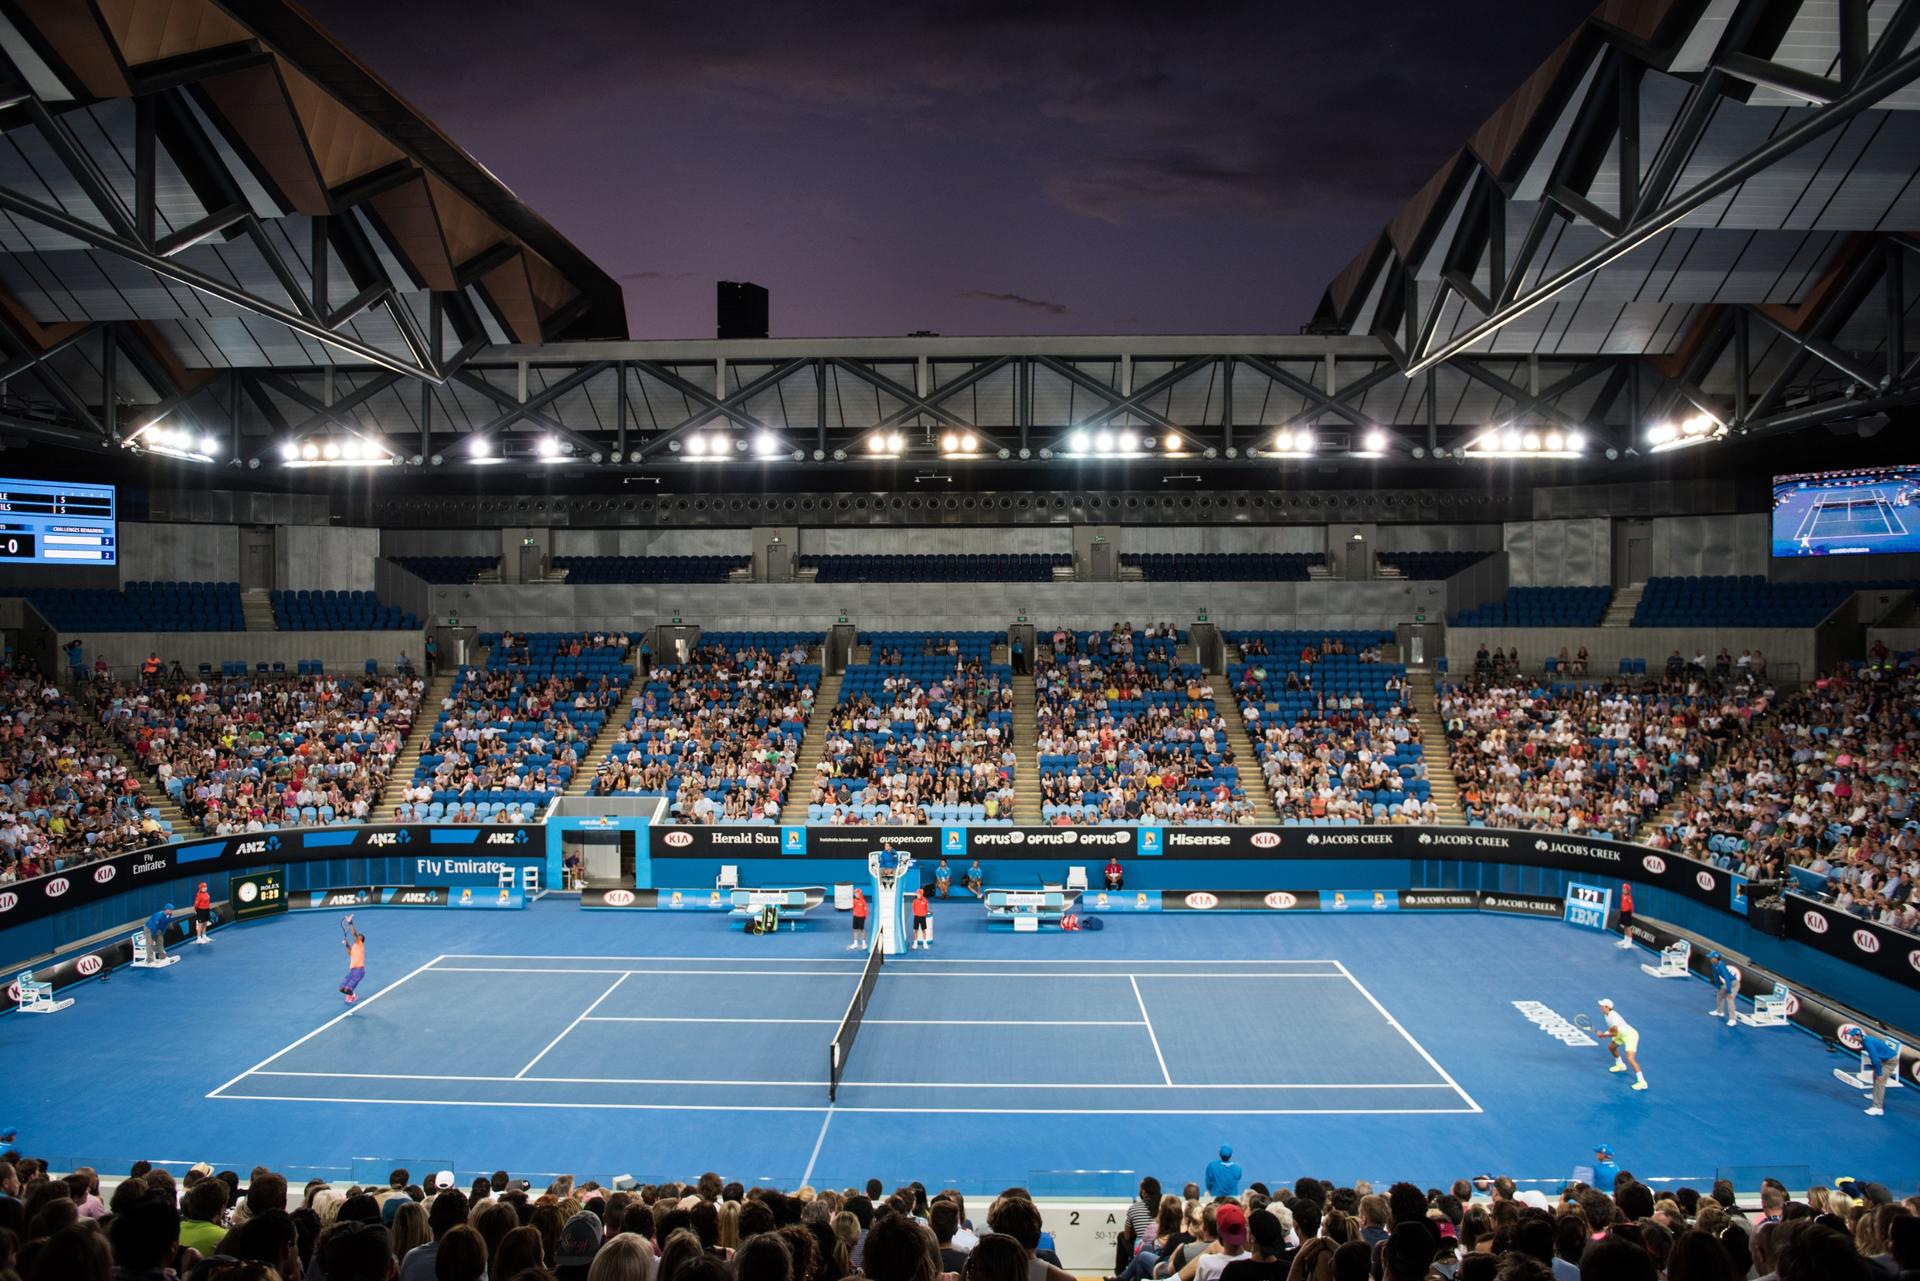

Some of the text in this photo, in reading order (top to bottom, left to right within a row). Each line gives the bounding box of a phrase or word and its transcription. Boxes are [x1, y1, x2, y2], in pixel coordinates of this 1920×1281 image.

[367, 833, 396, 844] ANZ
[487, 833, 515, 844] ANZ
[712, 833, 779, 843] Herald Sun
[879, 836, 933, 845] ausopen.com
[974, 834, 1011, 845] OPTUS
[1027, 834, 1064, 845] OPTUS
[1080, 834, 1117, 845] OPTUS
[1169, 834, 1231, 845] Hisense
[1320, 835, 1393, 845] JACOB'S CREEK
[1432, 835, 1510, 847] JACOB'S CREEK
[236, 841, 266, 854] ANZ
[1549, 843, 1621, 861] JACOB'S CREEK
[133, 860, 166, 874] Emirates
[417, 859, 506, 876] Fly Emirates
[260, 883, 280, 891] ROLEX
[330, 894, 355, 905] ANZ
[402, 893, 426, 903] ANZ
[1446, 896, 1472, 904] CREEK
[1529, 902, 1557, 912] CREEK
[1570, 907, 1600, 928] IBM
[1070, 1211, 1116, 1226] 2 A
